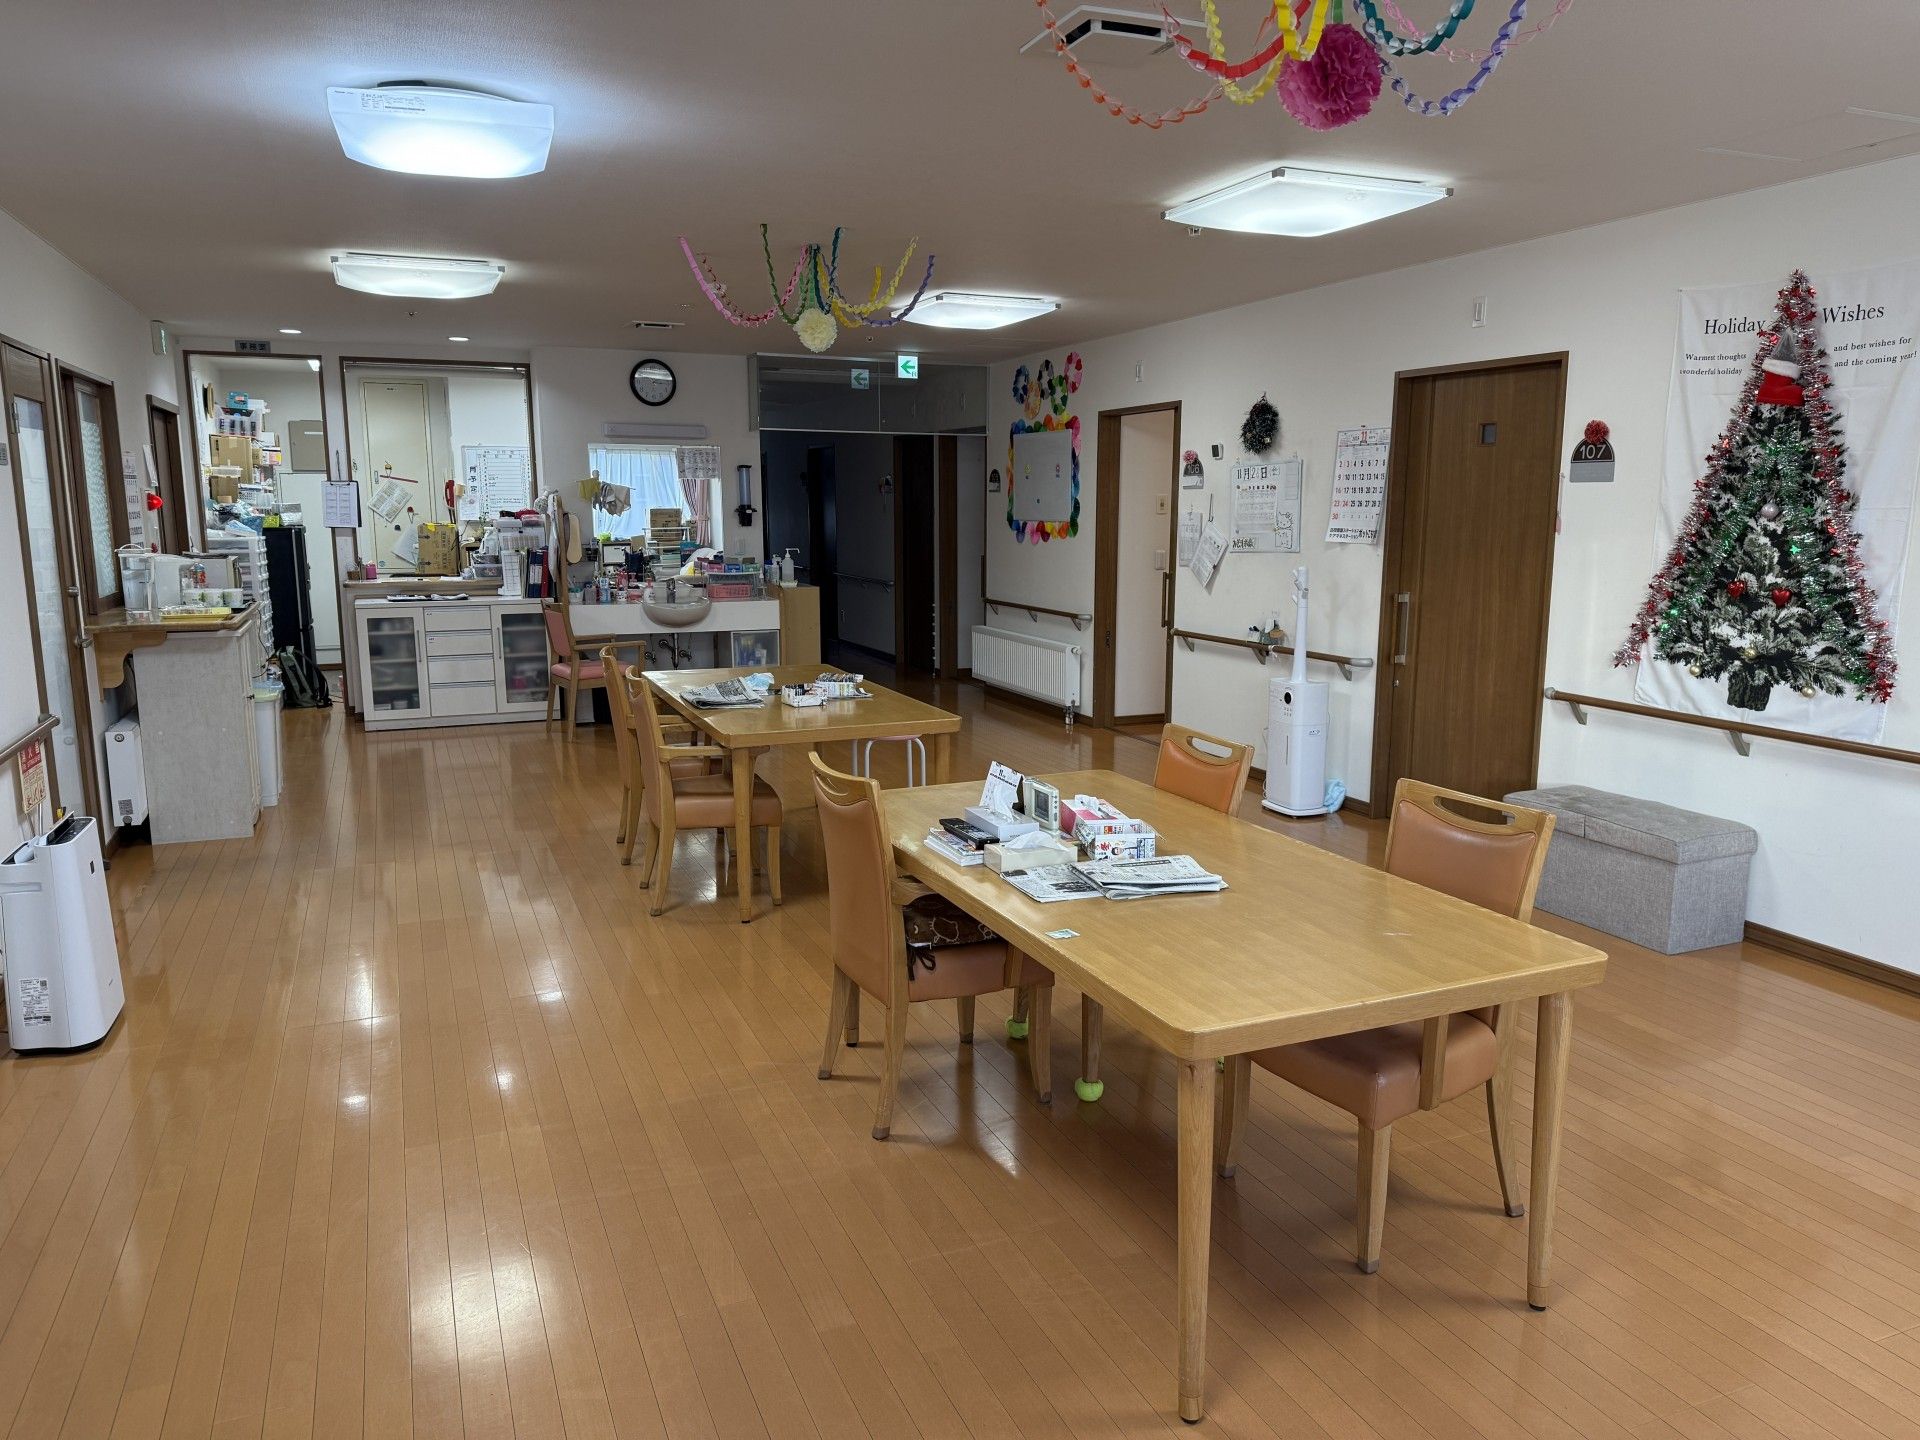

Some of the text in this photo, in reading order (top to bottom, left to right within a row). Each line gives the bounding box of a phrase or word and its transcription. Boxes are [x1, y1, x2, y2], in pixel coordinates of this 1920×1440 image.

[1704, 303, 1885, 335] Holiday Wishes
[1685, 336, 1912, 363] Warmest thoughts and best wishes for
[1679, 350, 1918, 375] wonderful holiday and the coming year!
[1580, 444, 1606, 459] 107
[1187, 464, 1200, 474] 106
